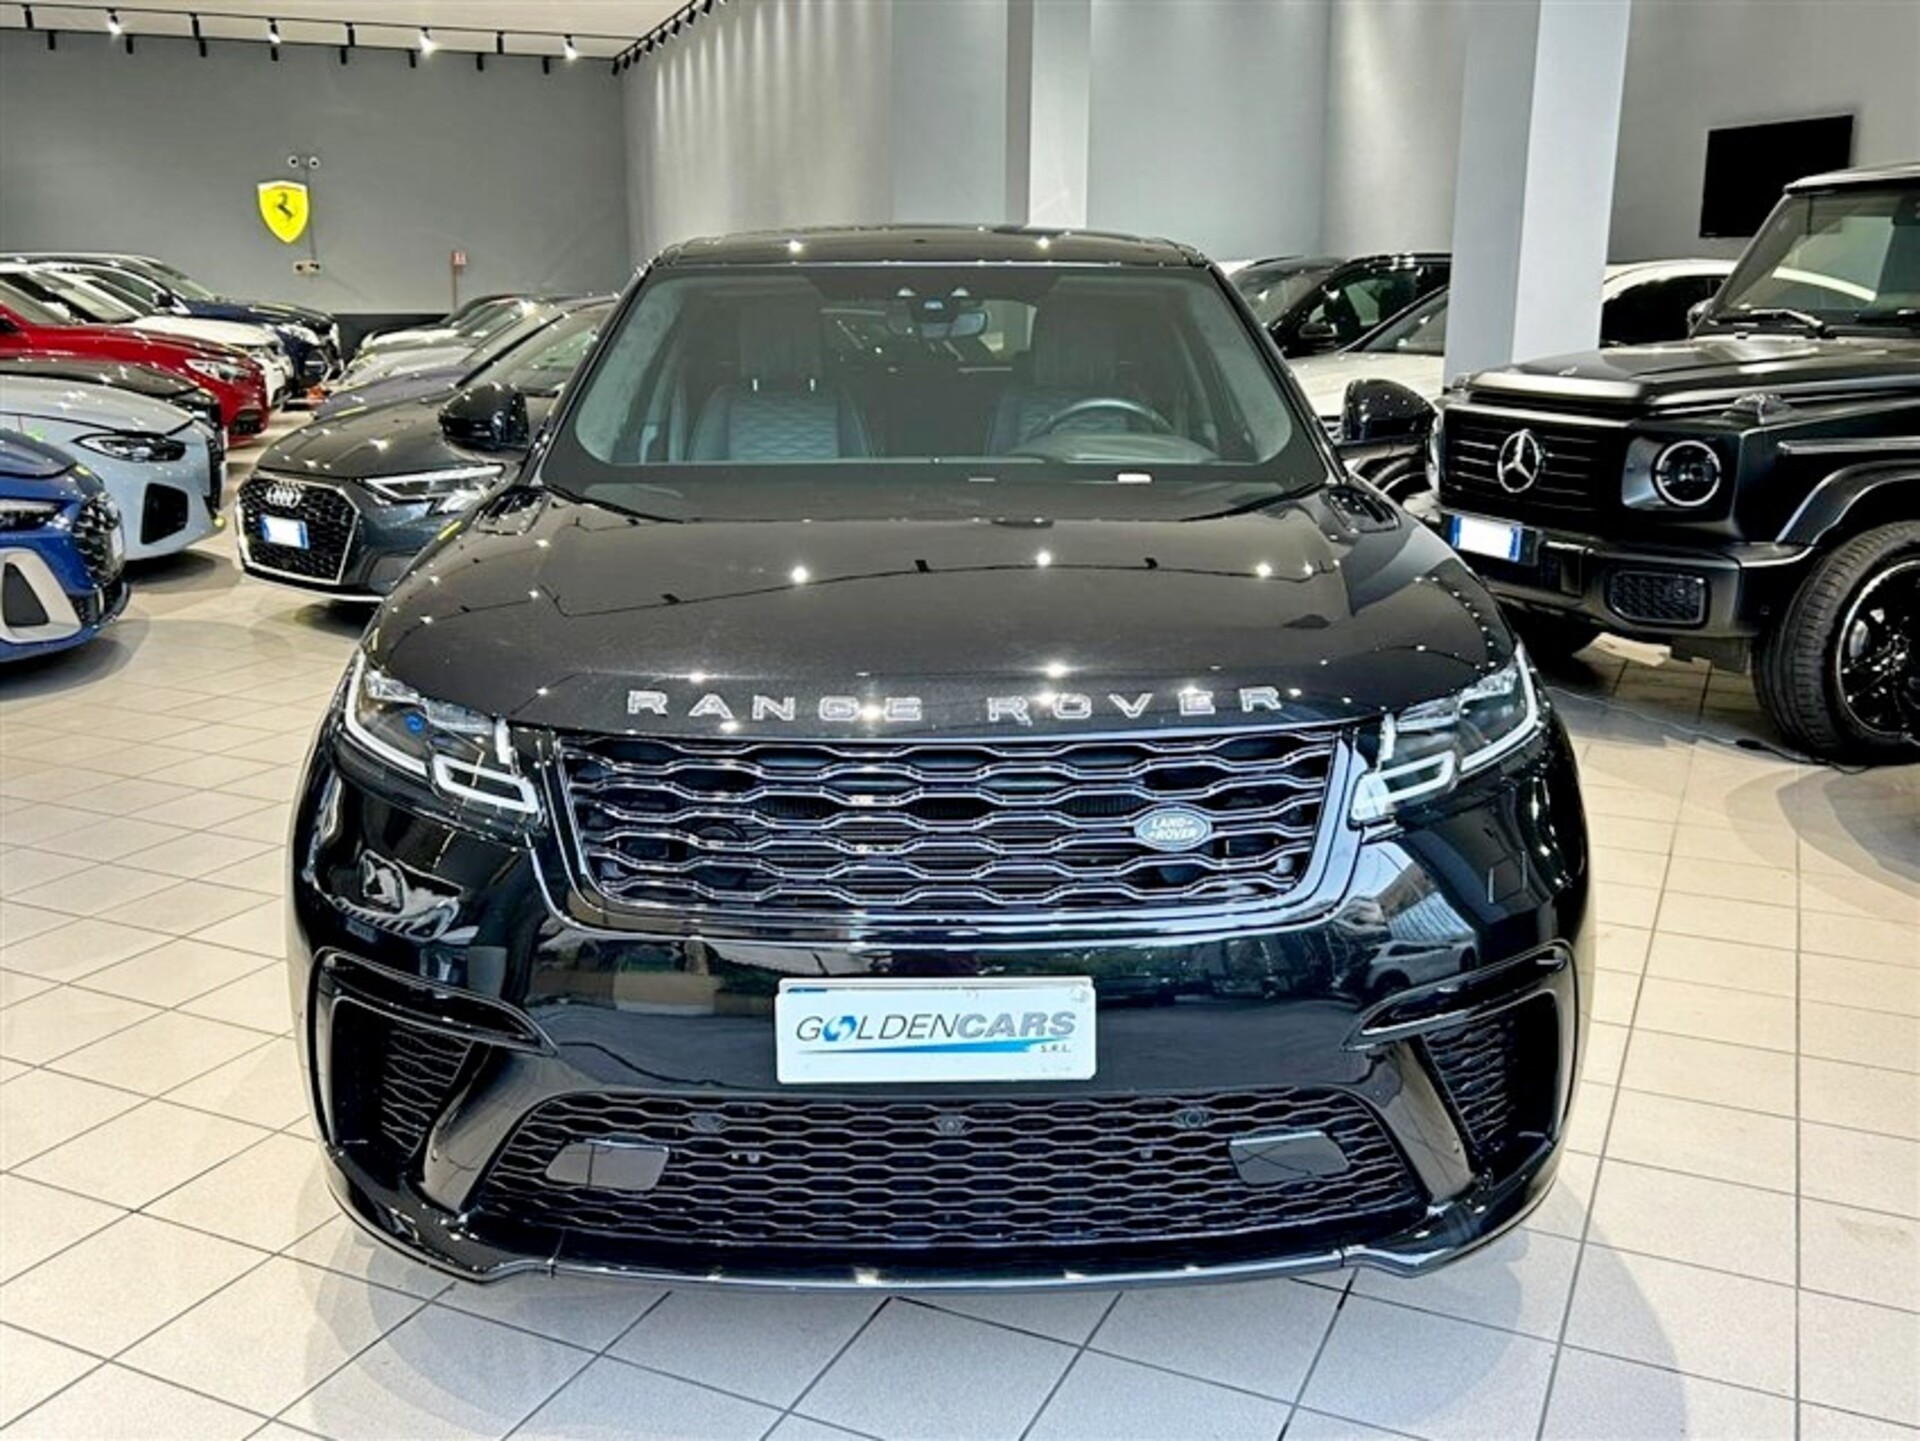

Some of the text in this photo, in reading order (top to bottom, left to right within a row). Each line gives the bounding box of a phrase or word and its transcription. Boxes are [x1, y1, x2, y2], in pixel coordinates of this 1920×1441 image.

[626, 686, 1282, 725] RANGE ROVER
[1155, 828, 1198, 841] ROVER
[796, 1011, 1076, 1042] GOLDENCARS
